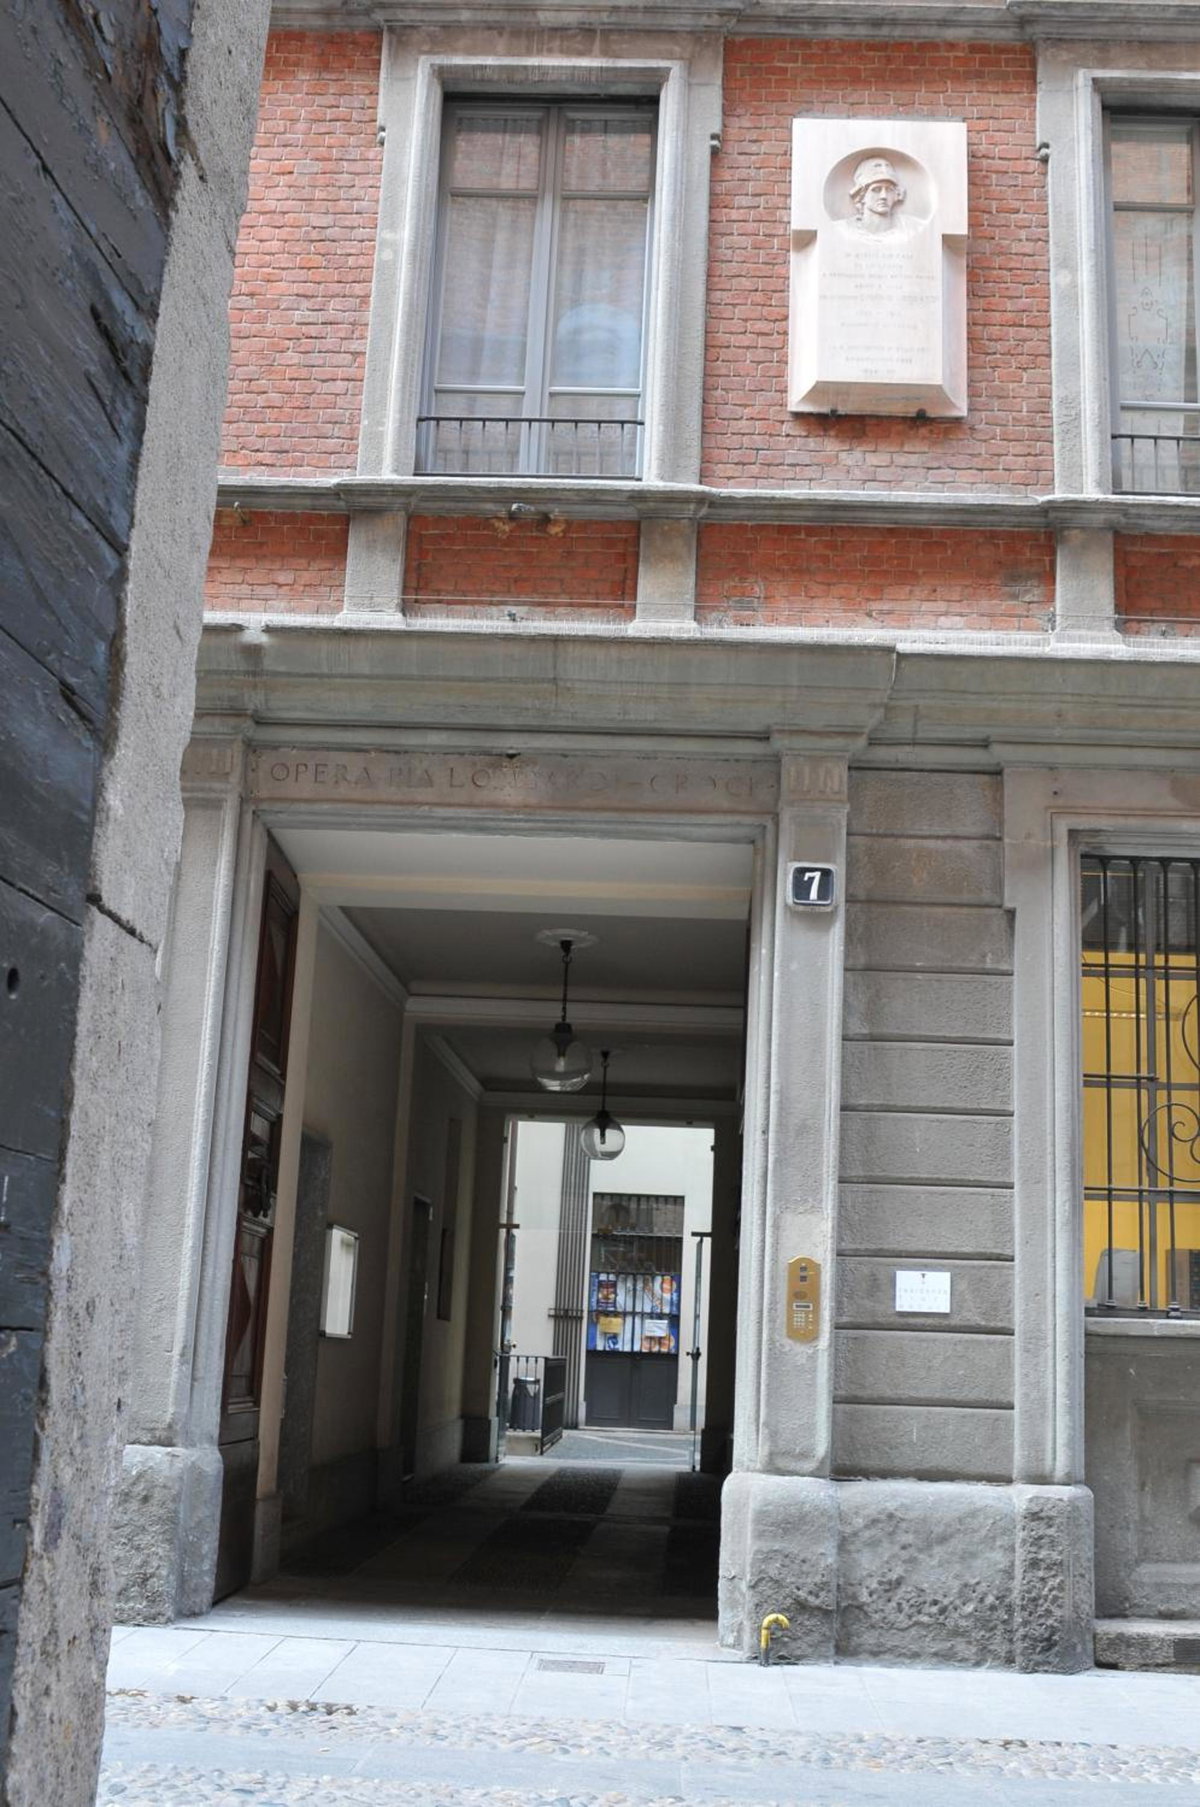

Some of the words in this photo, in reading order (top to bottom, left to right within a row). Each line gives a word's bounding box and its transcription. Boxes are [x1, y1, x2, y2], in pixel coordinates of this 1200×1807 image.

[270, 762, 374, 788] OPERA
[389, 767, 434, 788] PIA
[803, 871, 821, 900] 7
